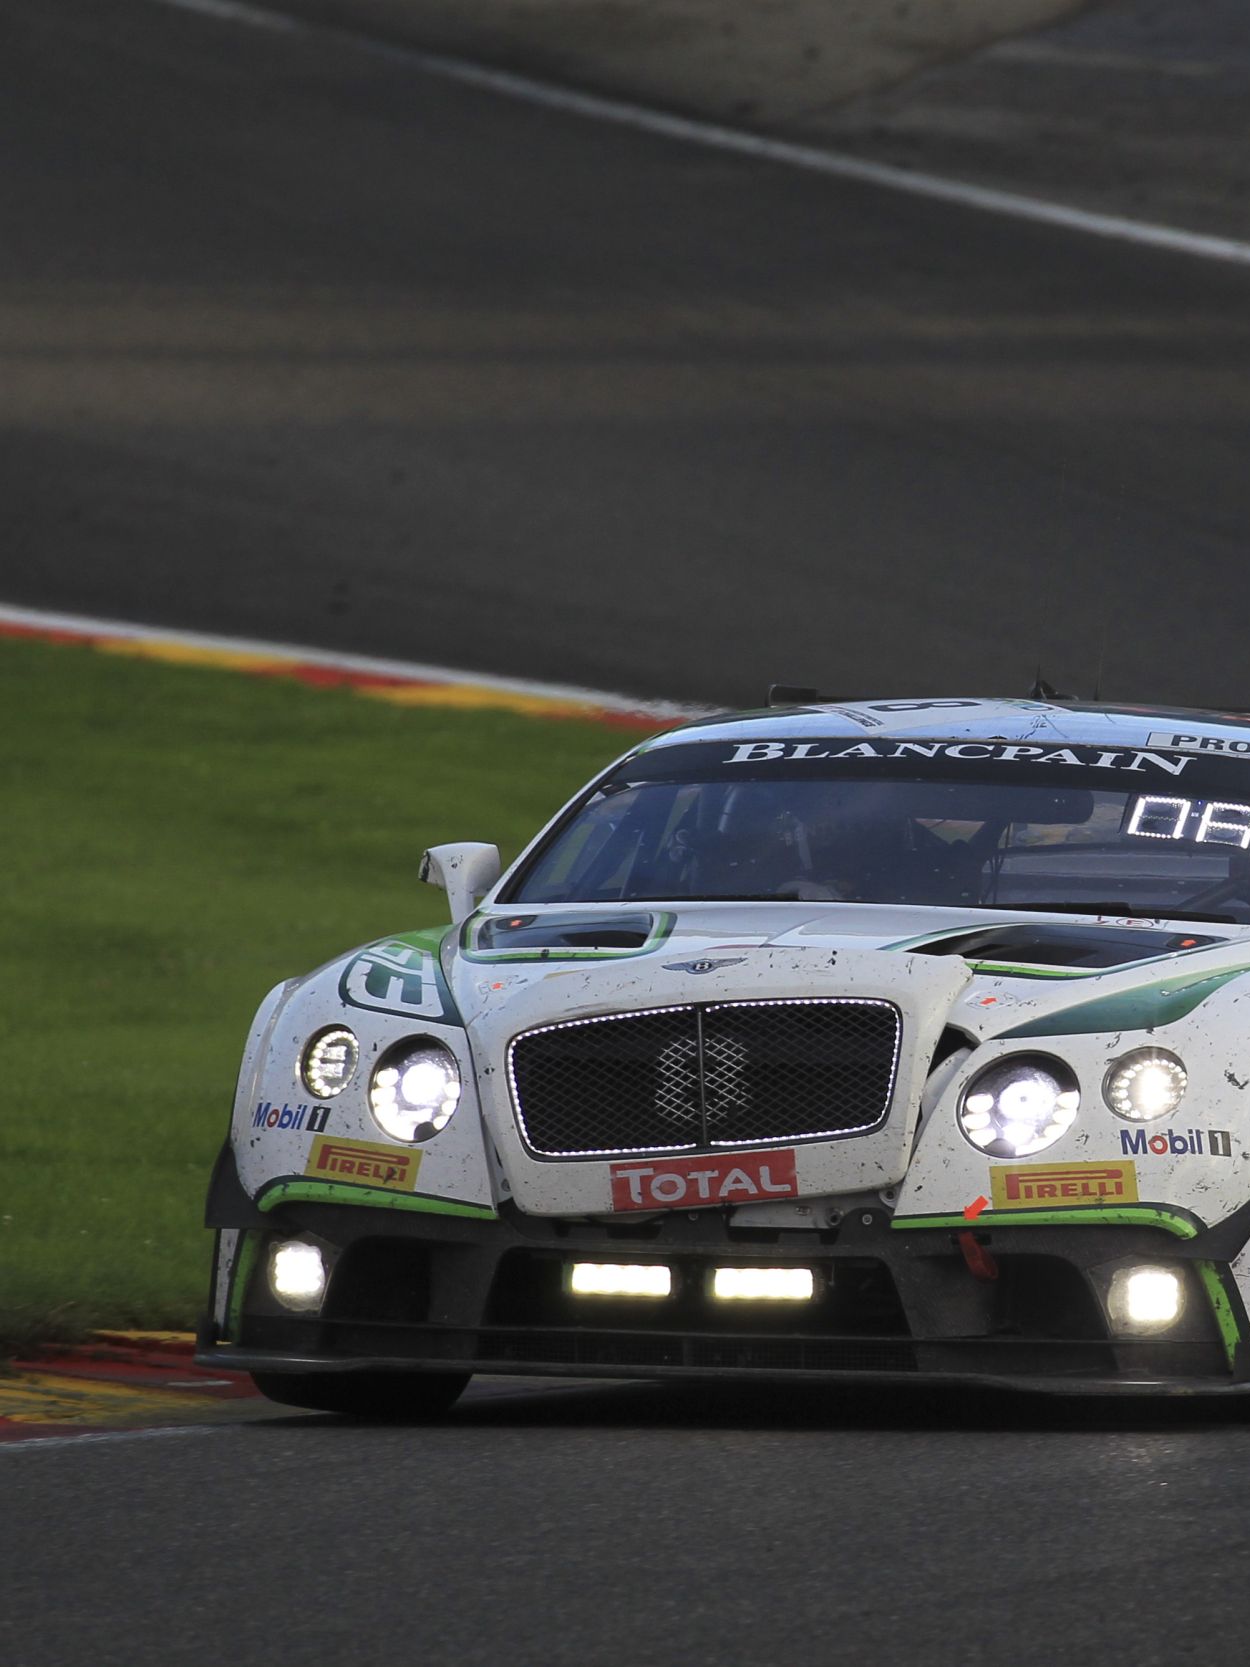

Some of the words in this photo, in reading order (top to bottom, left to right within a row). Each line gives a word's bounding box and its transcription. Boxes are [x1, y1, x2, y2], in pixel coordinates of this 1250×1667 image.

[721, 740, 1198, 776] BLANCPAIN
[252, 1103, 308, 1130] Mobil
[310, 1107, 328, 1131] 1
[1120, 1129, 1203, 1155] Mobil
[1210, 1131, 1229, 1156] 1
[316, 1143, 410, 1183] PIRELLI
[616, 1165, 792, 1205] TOTAL
[1005, 1169, 1124, 1200] PIRELLI
